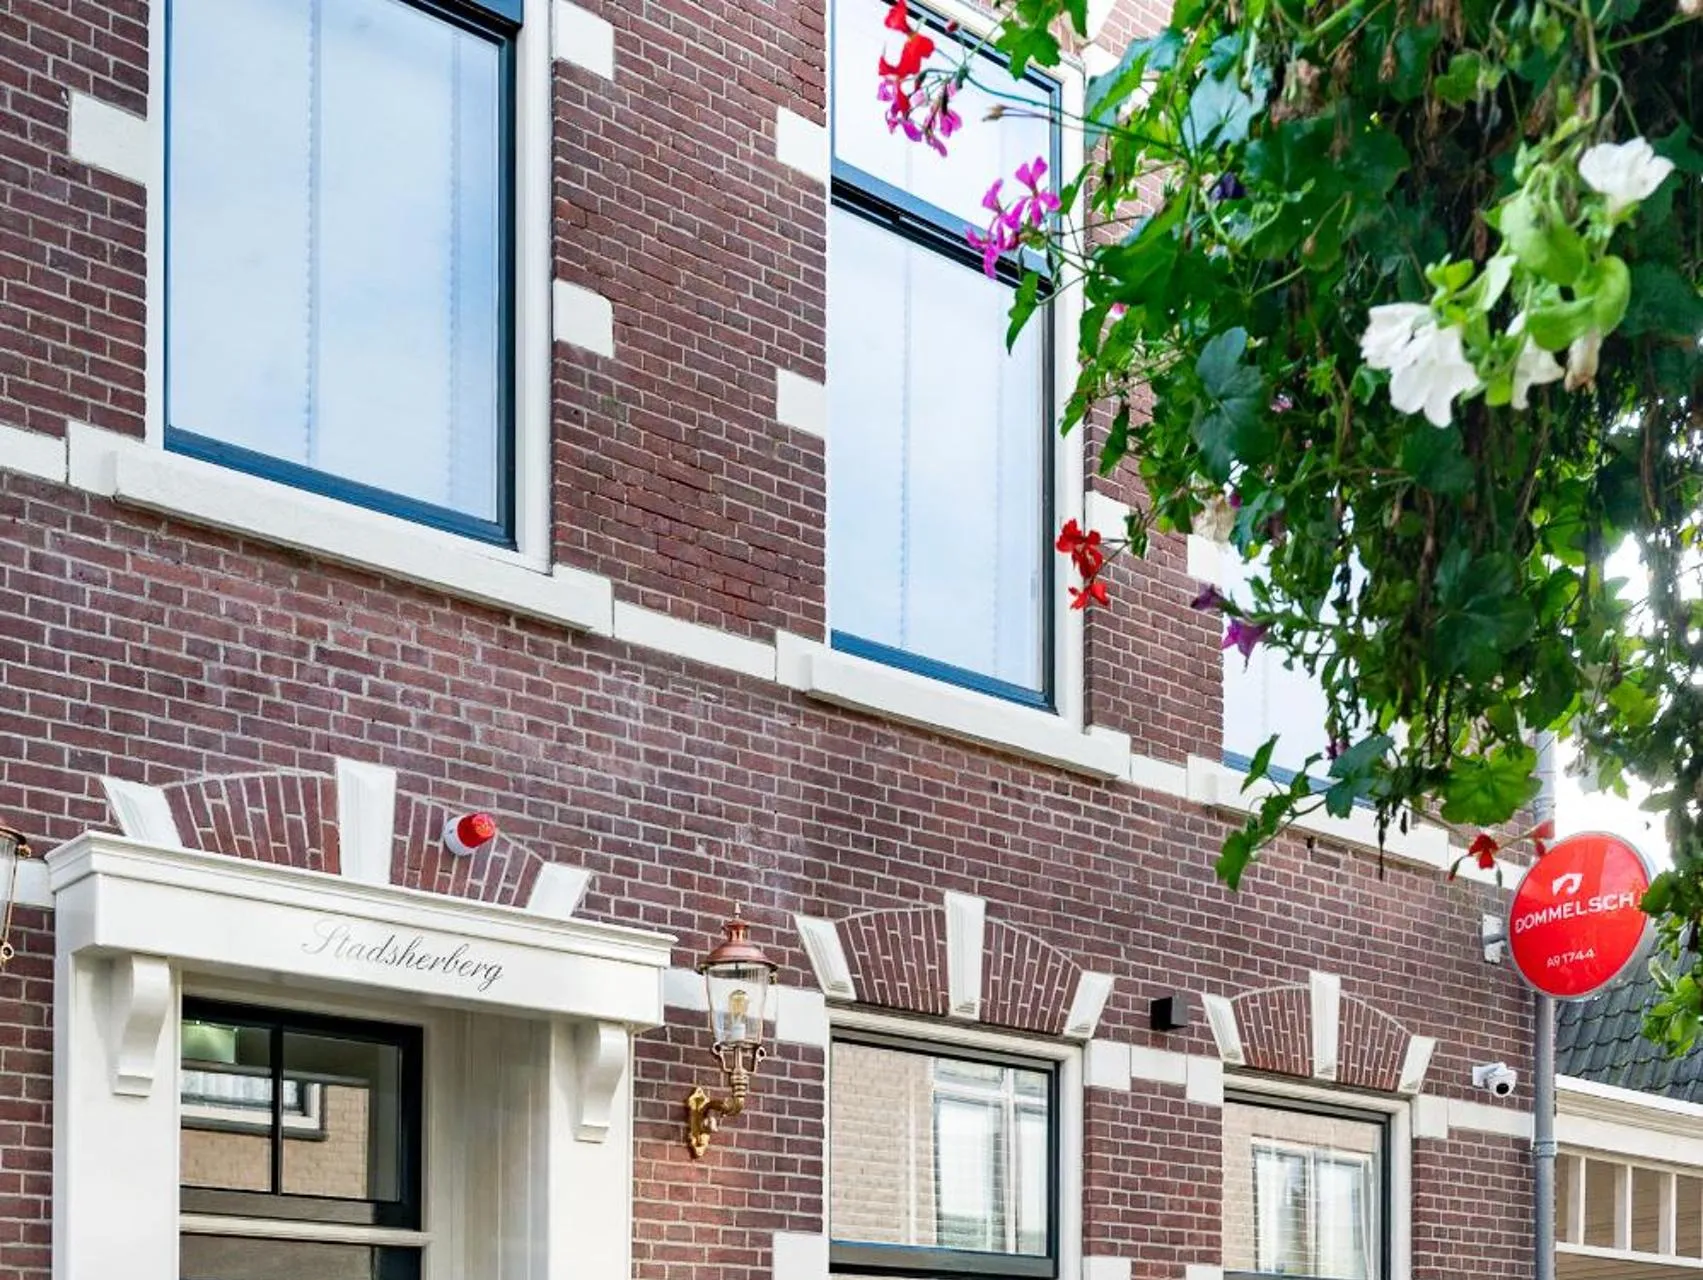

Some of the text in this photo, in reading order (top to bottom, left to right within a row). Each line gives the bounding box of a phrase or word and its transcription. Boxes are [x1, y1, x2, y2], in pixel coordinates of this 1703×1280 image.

[1515, 891, 1634, 934] DOMMELSCH
[302, 918, 503, 993] Stadsherberg
[1561, 947, 1596, 964] 1744
